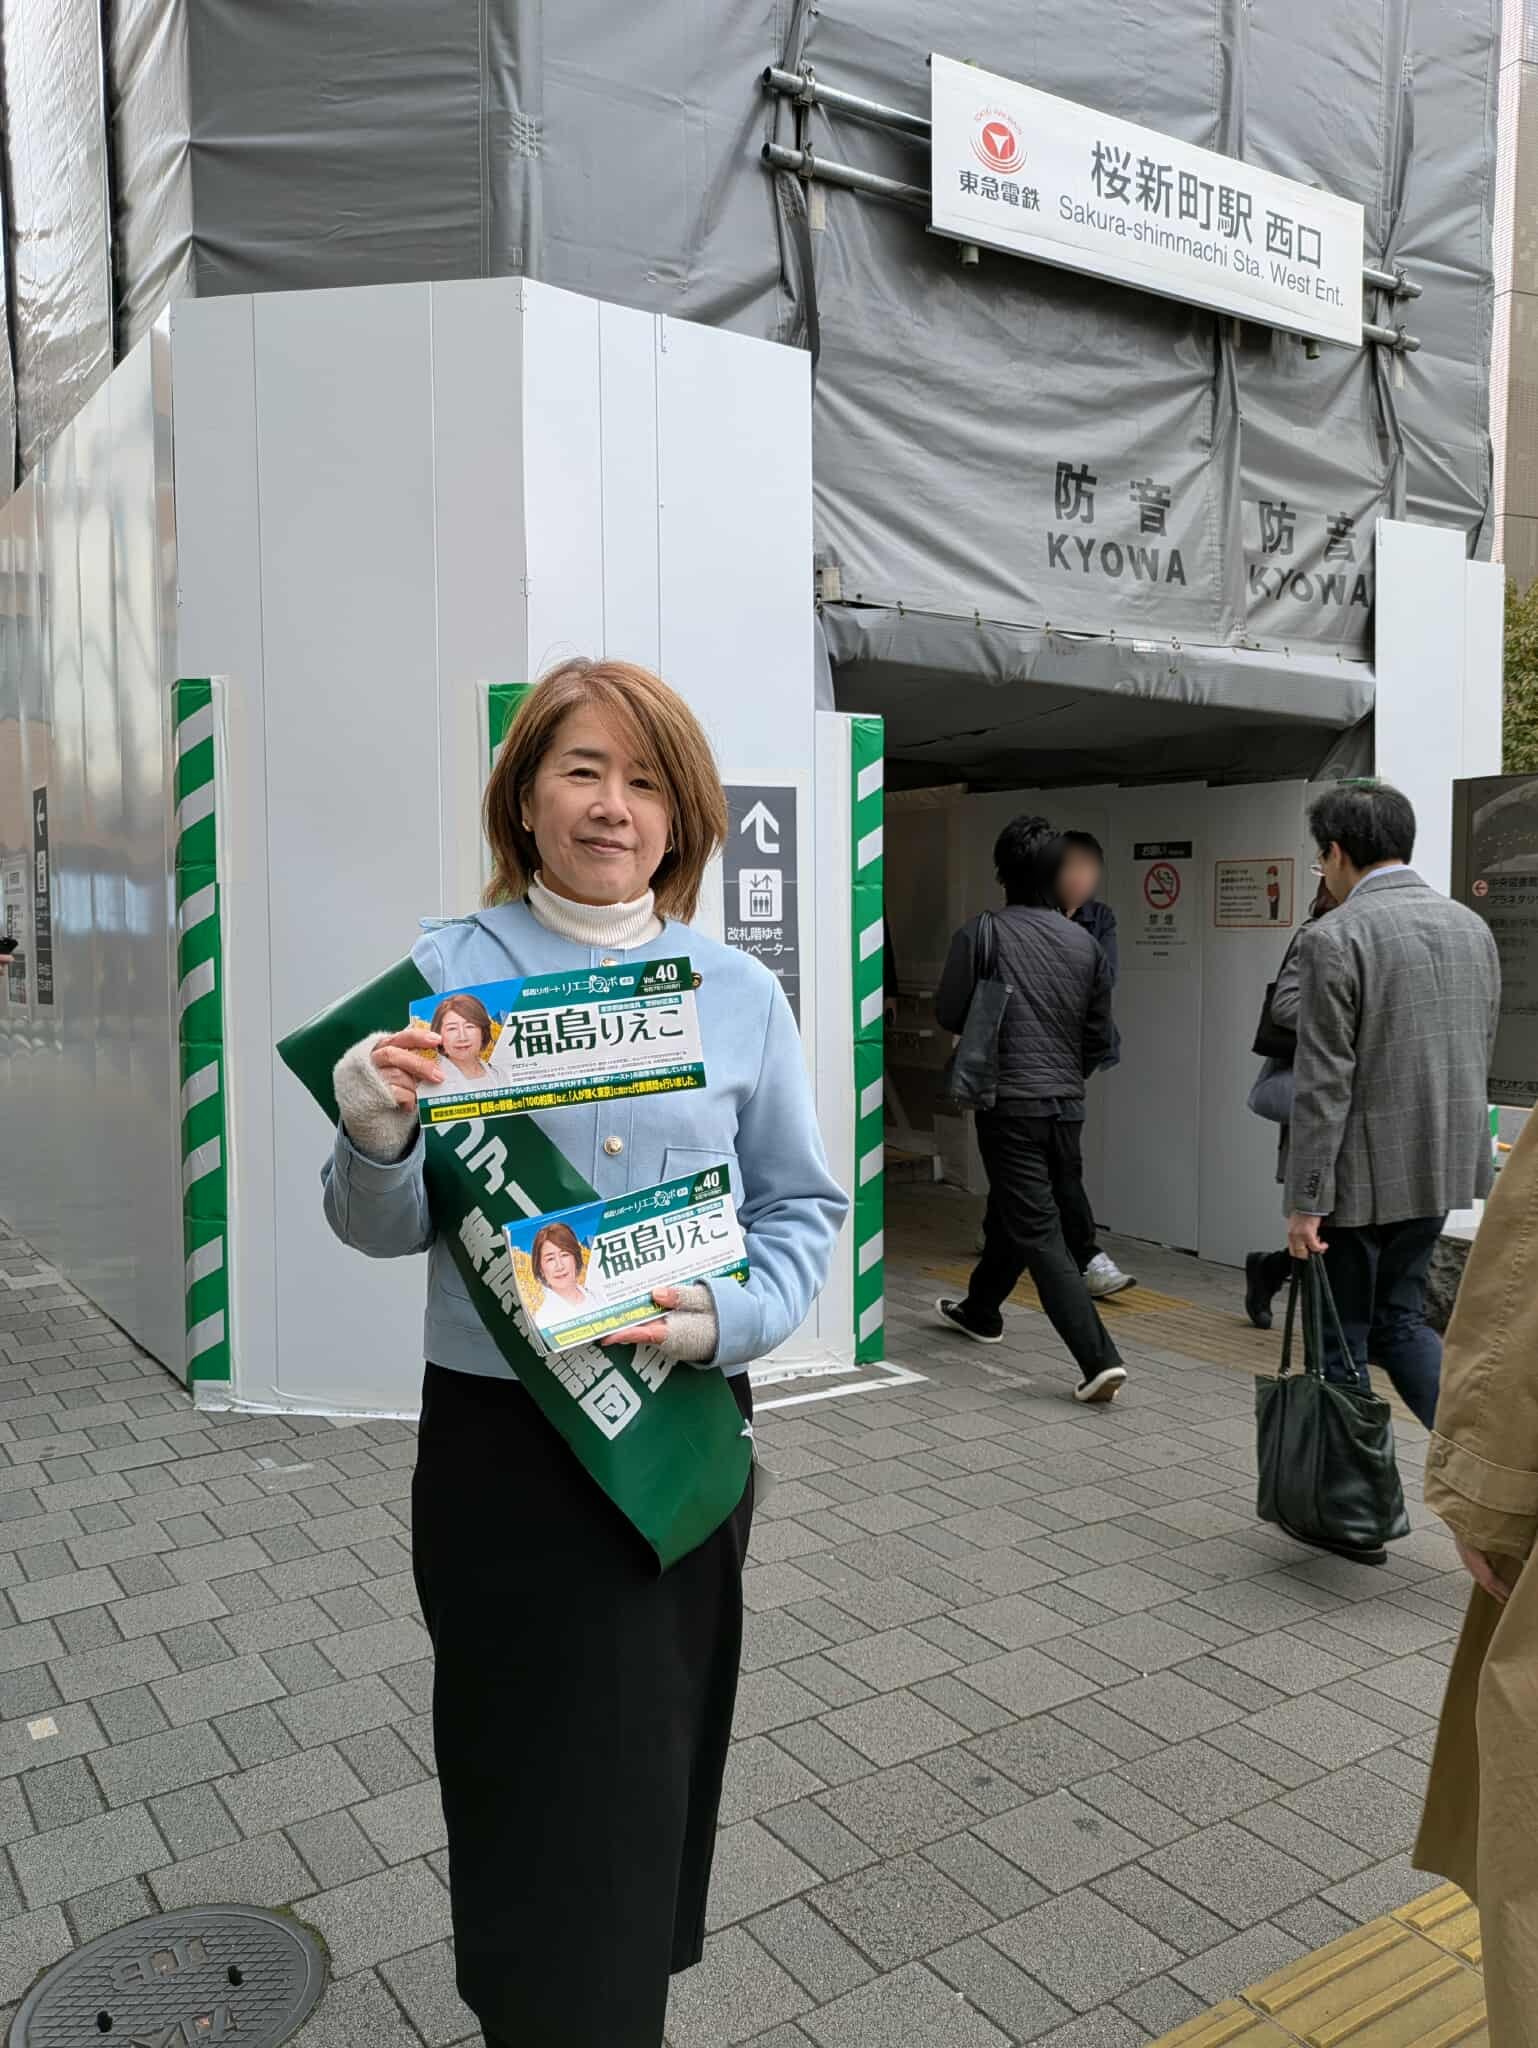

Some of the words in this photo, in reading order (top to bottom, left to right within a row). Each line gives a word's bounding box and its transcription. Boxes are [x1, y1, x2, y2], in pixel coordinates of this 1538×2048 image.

[958, 169, 1041, 213] 東急電鉄
[1090, 140, 1254, 244] 桜新町駅
[1265, 208, 1323, 270] 西口
[1059, 194, 1228, 268] Sakura-shimmachi
[1233, 249, 1265, 280] Sta.
[1269, 260, 1311, 294] West
[1315, 279, 1345, 307] Ent.
[1054, 461, 1172, 537] 防音
[1047, 531, 1187, 586] KYOWA
[1250, 564, 1369, 607] KYOWA
[727, 926, 784, 941] 改札階ゆき
[655, 963, 678, 983] 40
[508, 1008, 684, 1060] 福島りえこ
[702, 1171, 721, 1189] 40
[595, 1213, 730, 1280] 福島りえこ
